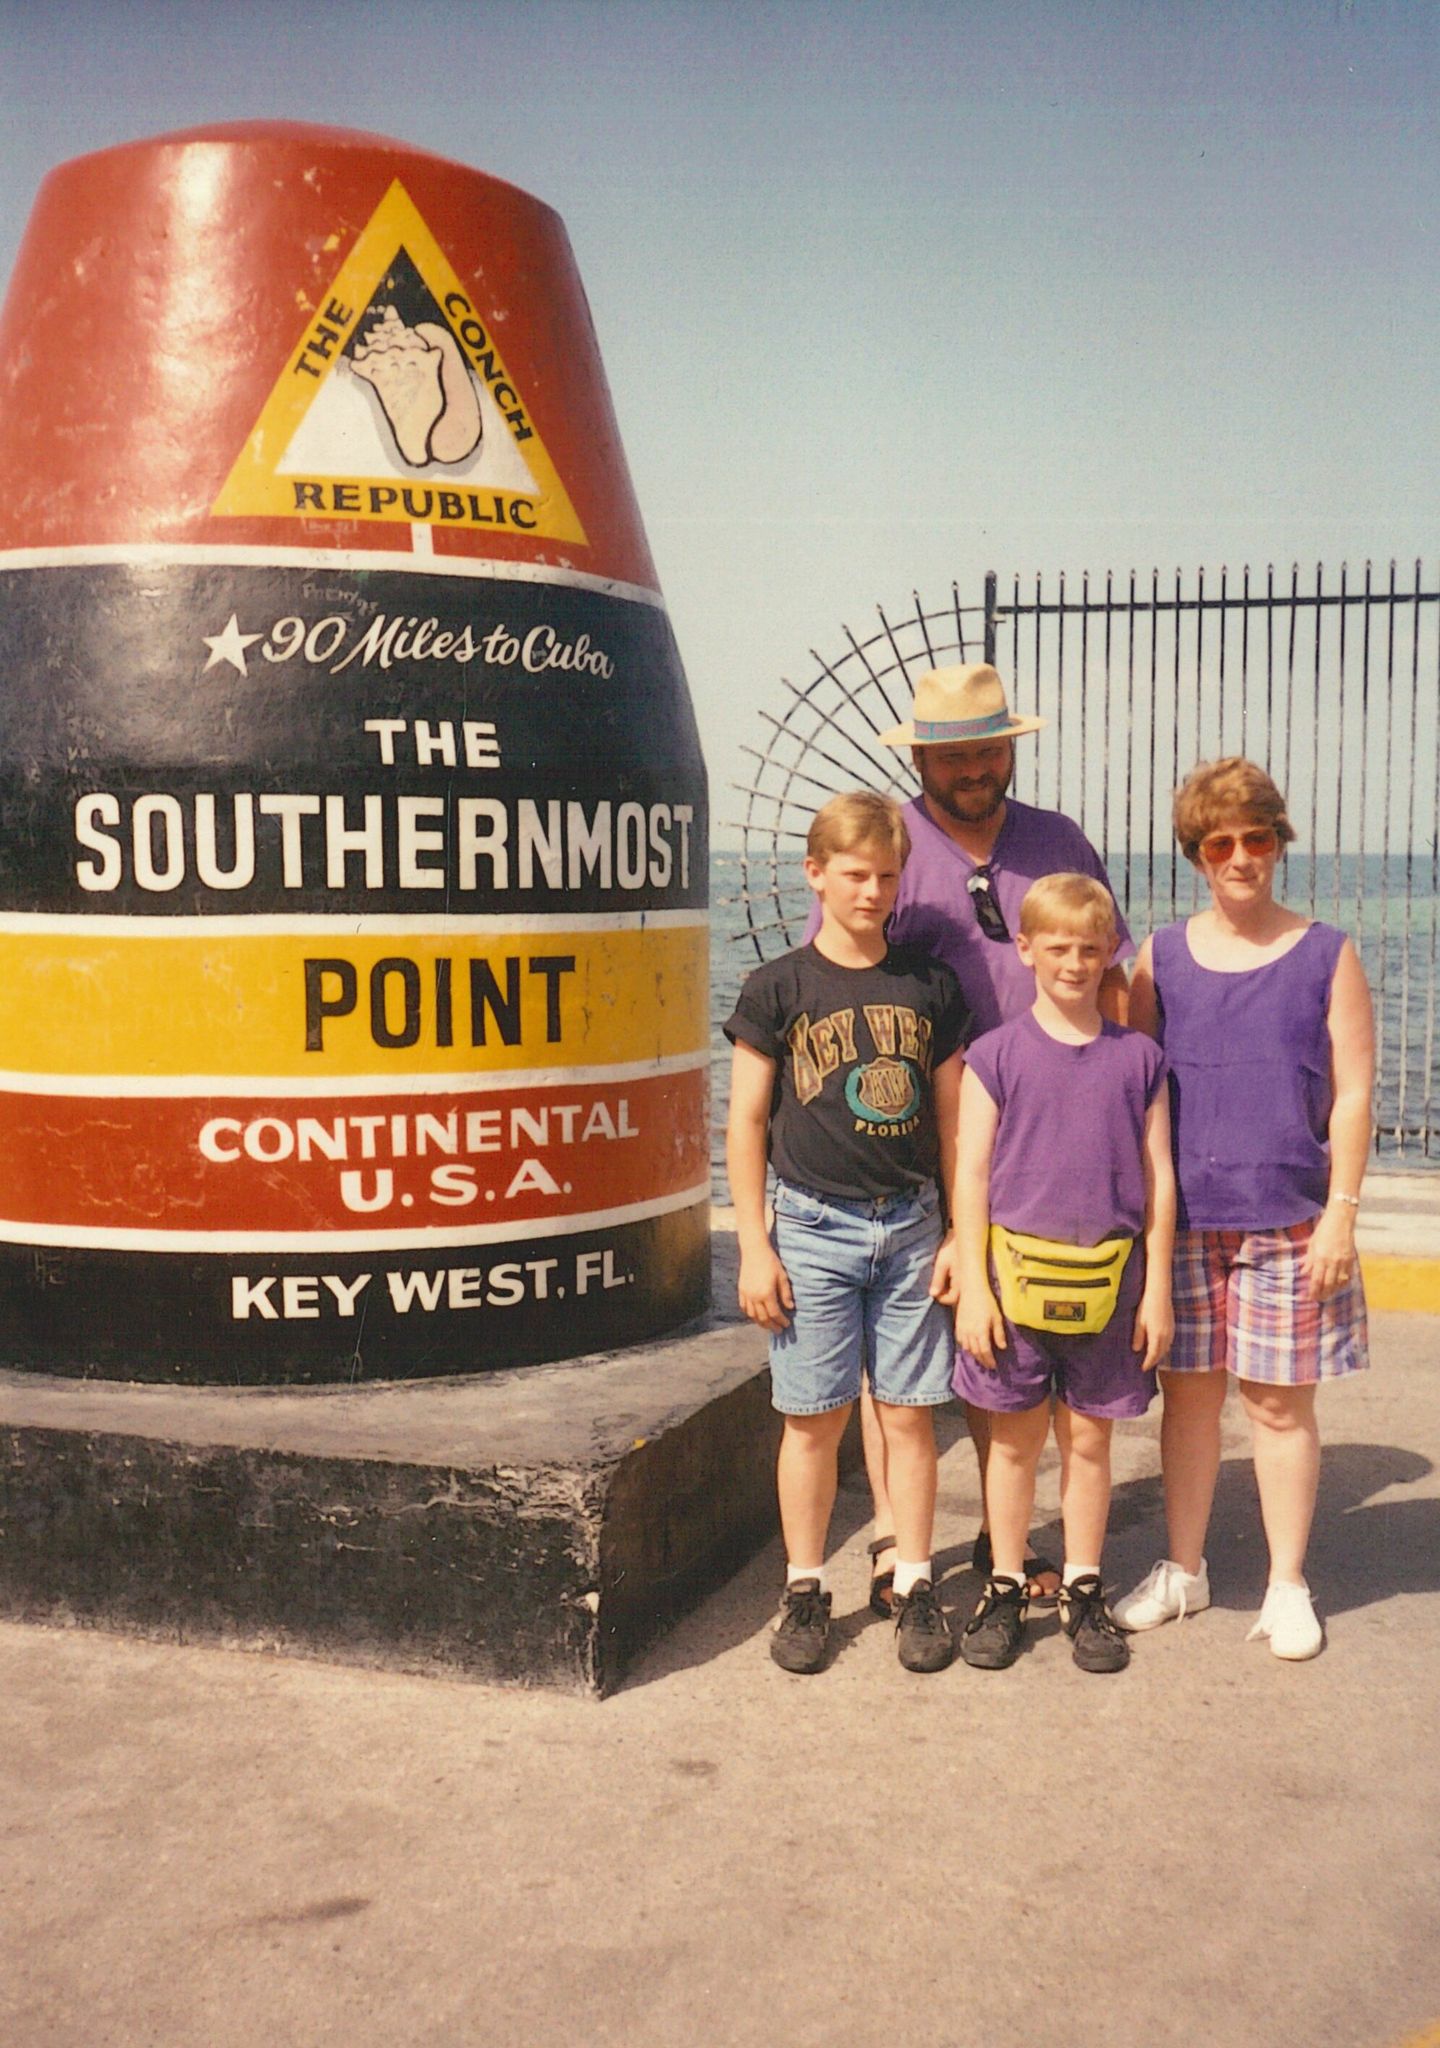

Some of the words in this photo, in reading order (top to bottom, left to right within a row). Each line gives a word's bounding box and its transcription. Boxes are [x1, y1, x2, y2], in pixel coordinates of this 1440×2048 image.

[294, 296, 354, 379] THE
[444, 292, 533, 441] CONCH
[292, 482, 538, 529] REPUBLIC
[261, 616, 346, 664] 90
[330, 613, 480, 675] Miles
[480, 624, 522, 666] to
[521, 624, 615, 681] Cuba
[364, 718, 502, 768] THE
[75, 792, 694, 893] SOUTHERNMOST
[303, 956, 577, 1052] POINT
[199, 1100, 640, 1164] CONTINENTAL
[340, 1158, 573, 1213] U.S.A.
[232, 1273, 373, 1320] KEY
[576, 1250, 635, 1296] FL.
